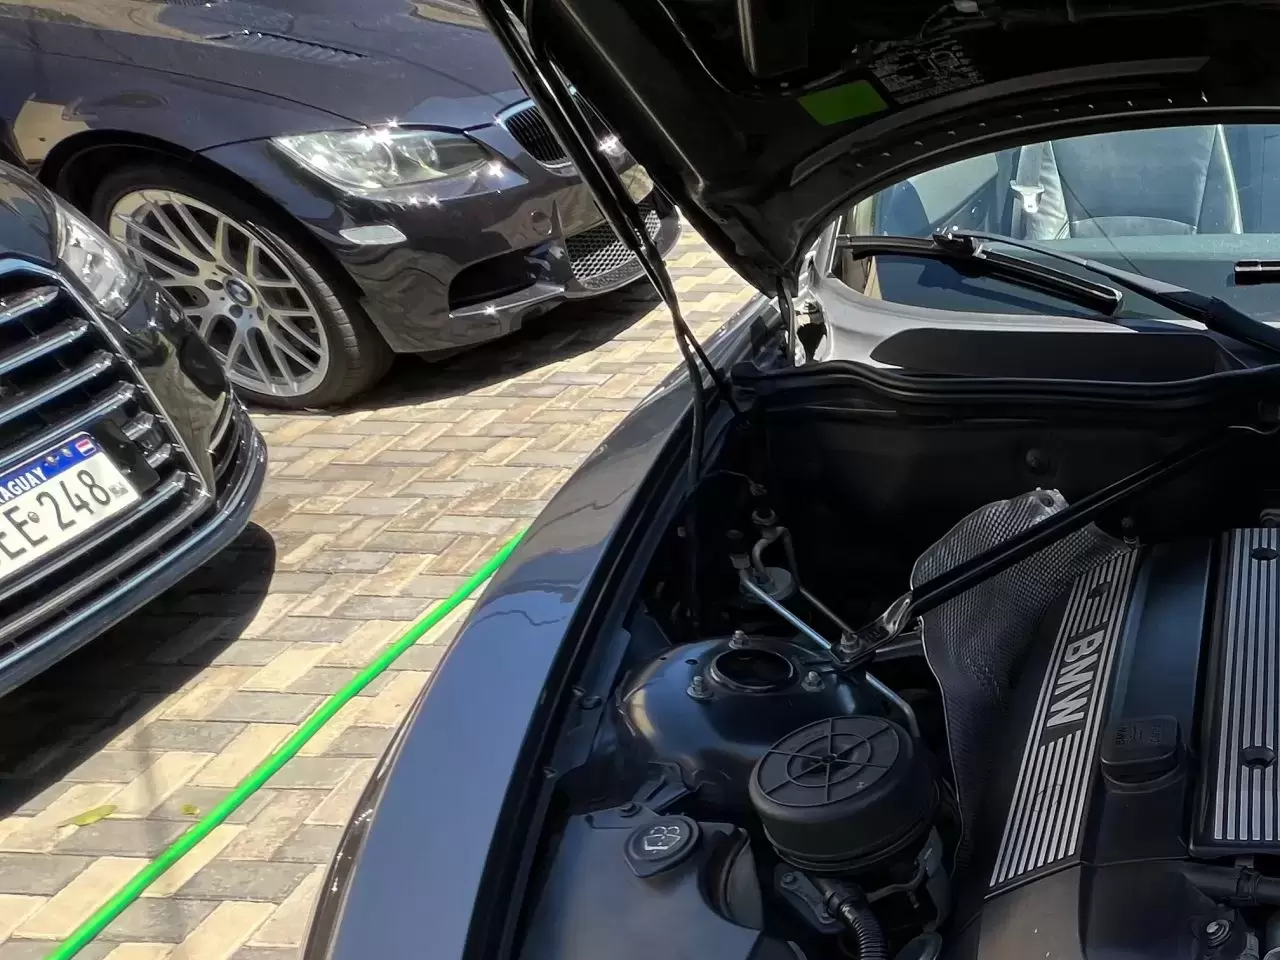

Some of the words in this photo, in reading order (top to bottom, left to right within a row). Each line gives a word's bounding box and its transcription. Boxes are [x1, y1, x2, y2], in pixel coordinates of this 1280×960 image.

[0, 466, 47, 505] AGUAY
[35, 469, 111, 531] 248
[1046, 629, 1105, 727] BMW
